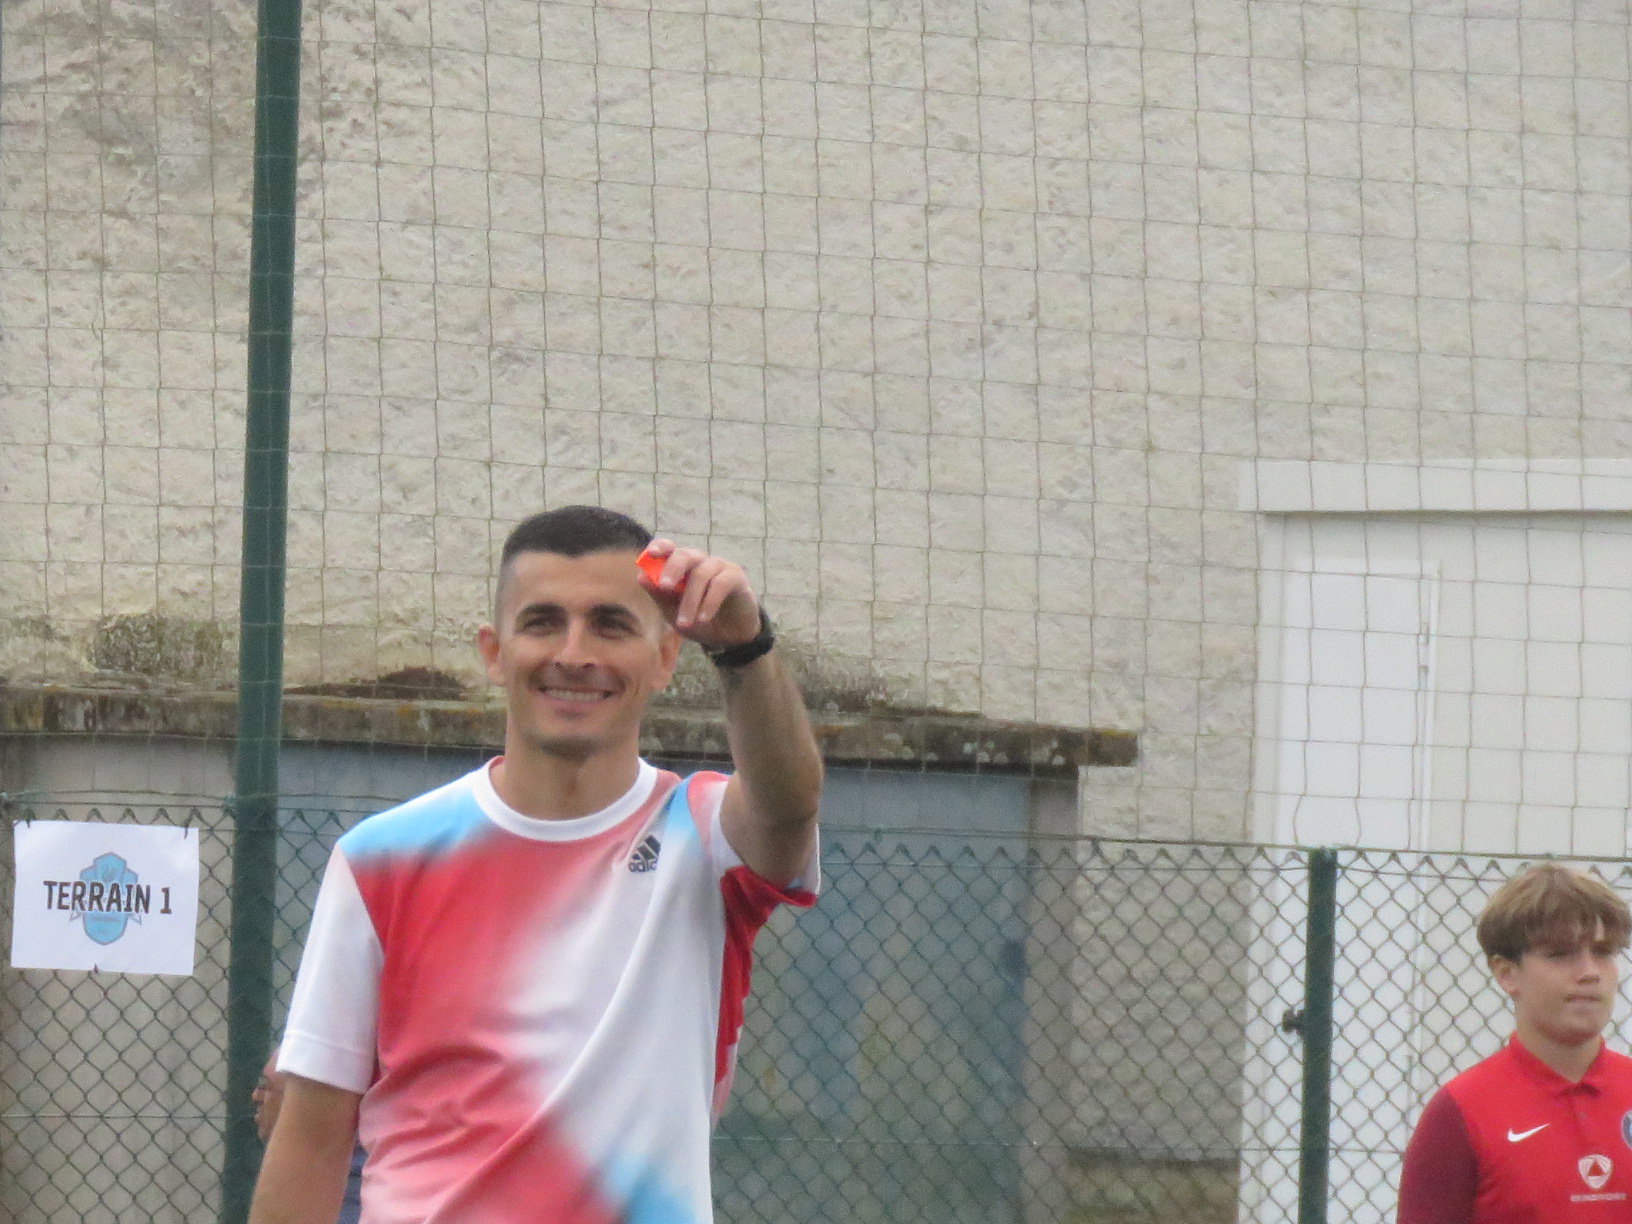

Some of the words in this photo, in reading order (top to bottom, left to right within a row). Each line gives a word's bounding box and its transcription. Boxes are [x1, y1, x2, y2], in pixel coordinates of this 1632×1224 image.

[628, 855, 658, 873] adid
[43, 880, 151, 914] TERRAIN
[160, 886, 172, 915] 1
